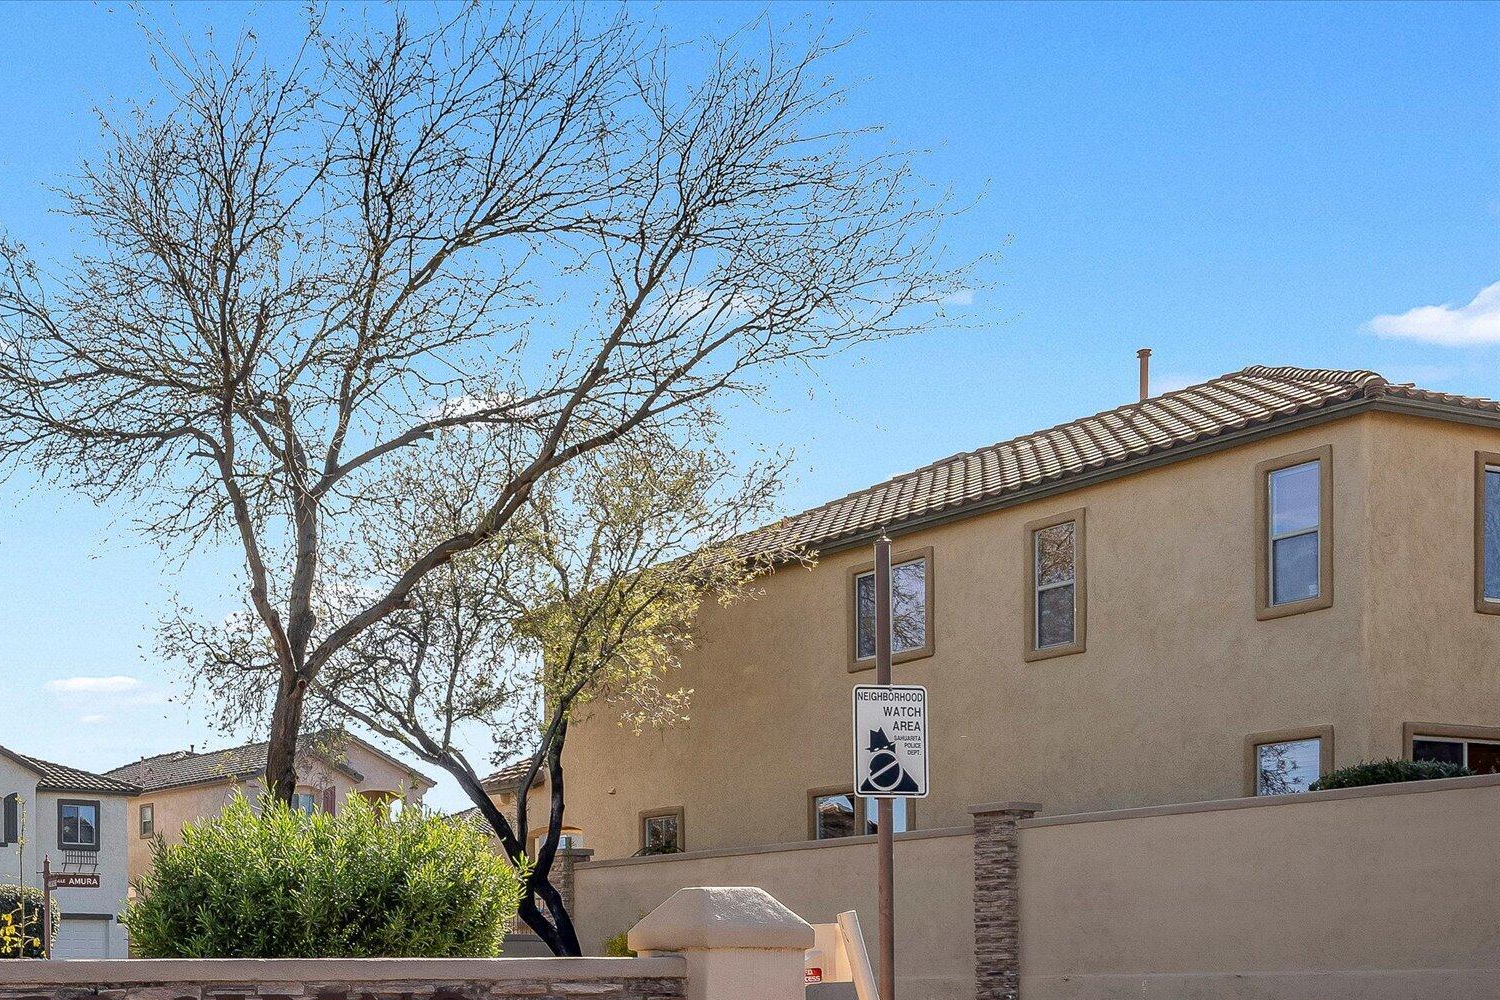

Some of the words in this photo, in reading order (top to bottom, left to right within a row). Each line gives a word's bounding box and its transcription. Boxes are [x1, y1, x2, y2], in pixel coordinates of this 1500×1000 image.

[857, 692, 923, 701] NEIGHBORHOOD
[883, 706, 921, 717] WATCH
[892, 721, 921, 731] AREA
